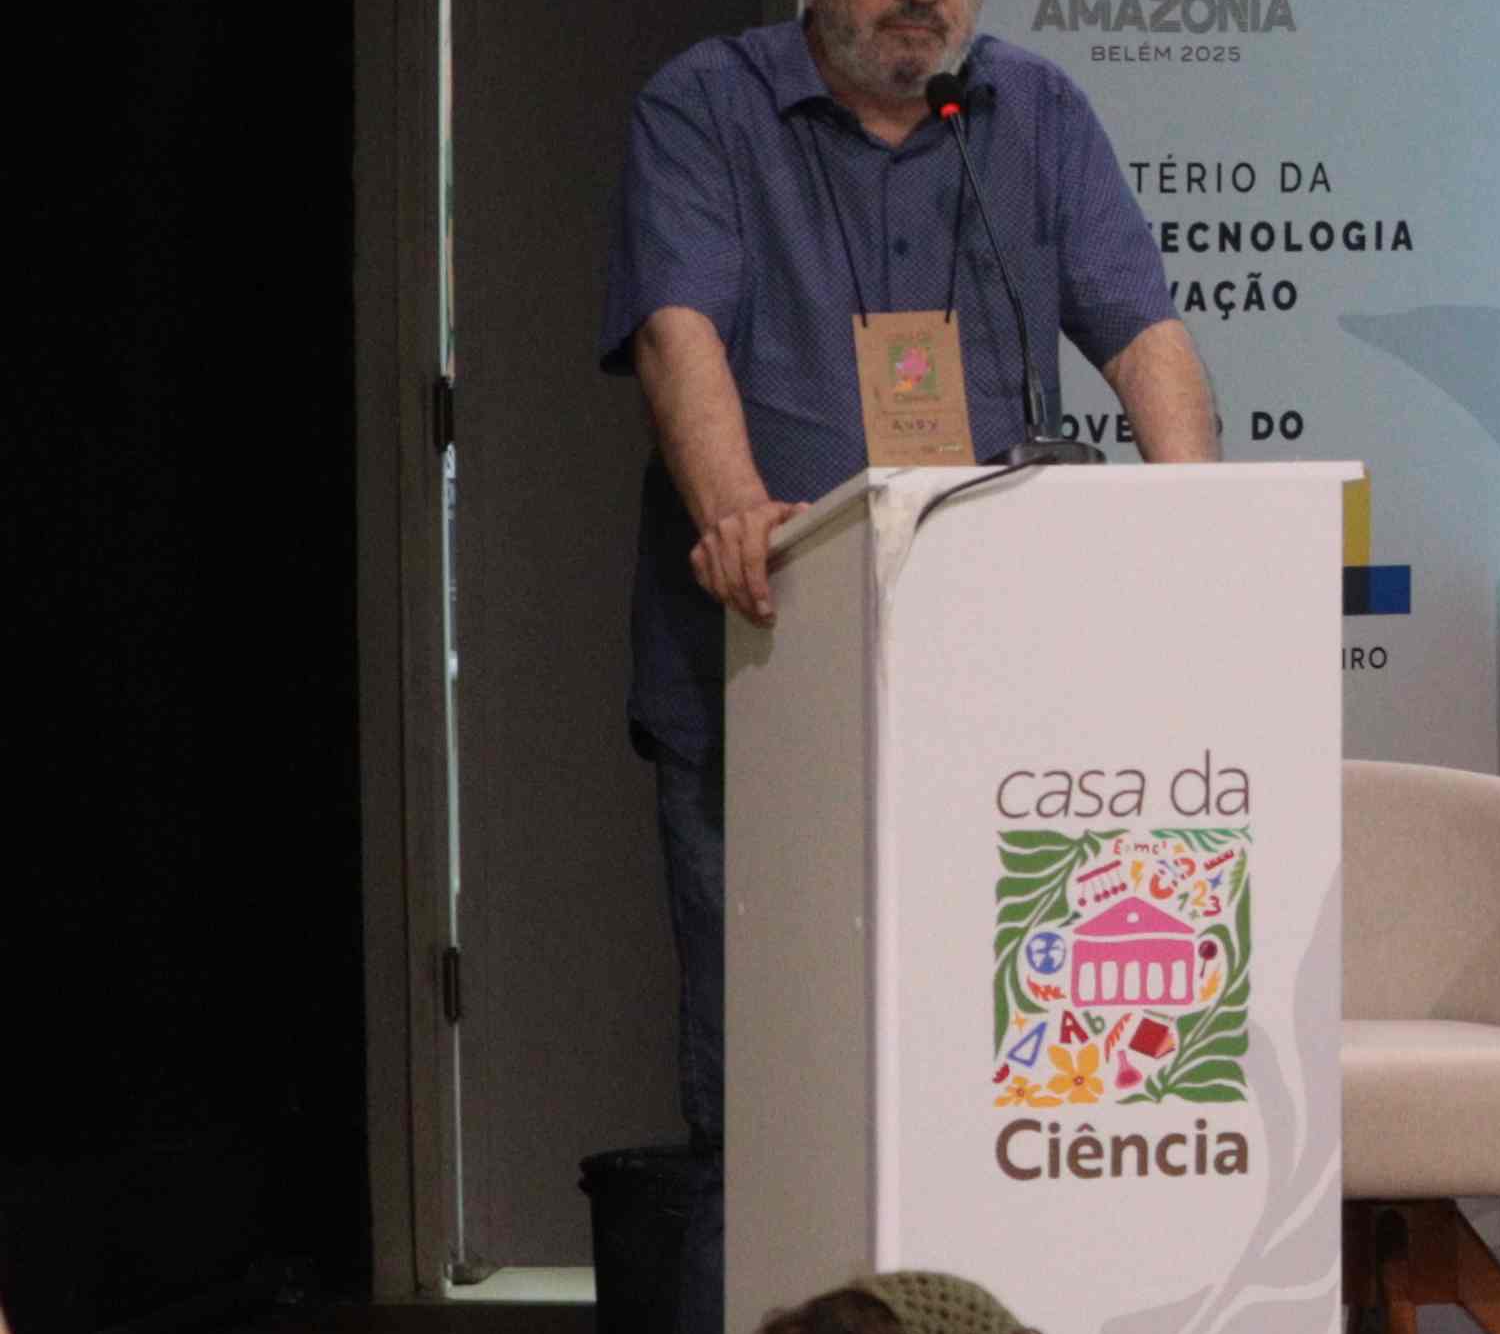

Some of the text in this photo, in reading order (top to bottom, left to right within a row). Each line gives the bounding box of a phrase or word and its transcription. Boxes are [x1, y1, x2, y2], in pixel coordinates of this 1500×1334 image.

[1091, 41, 1242, 63] BELÉM 2025
[1129, 154, 1332, 194] TÉRIO DA
[1150, 219, 1414, 254] ECNOLOGIA
[1169, 271, 1298, 321] AÇÃO
[1251, 410, 1304, 441] DO
[995, 749, 1250, 820] casa da
[1059, 1010, 1106, 1044] Ab
[994, 1118, 1250, 1181] Ciência
